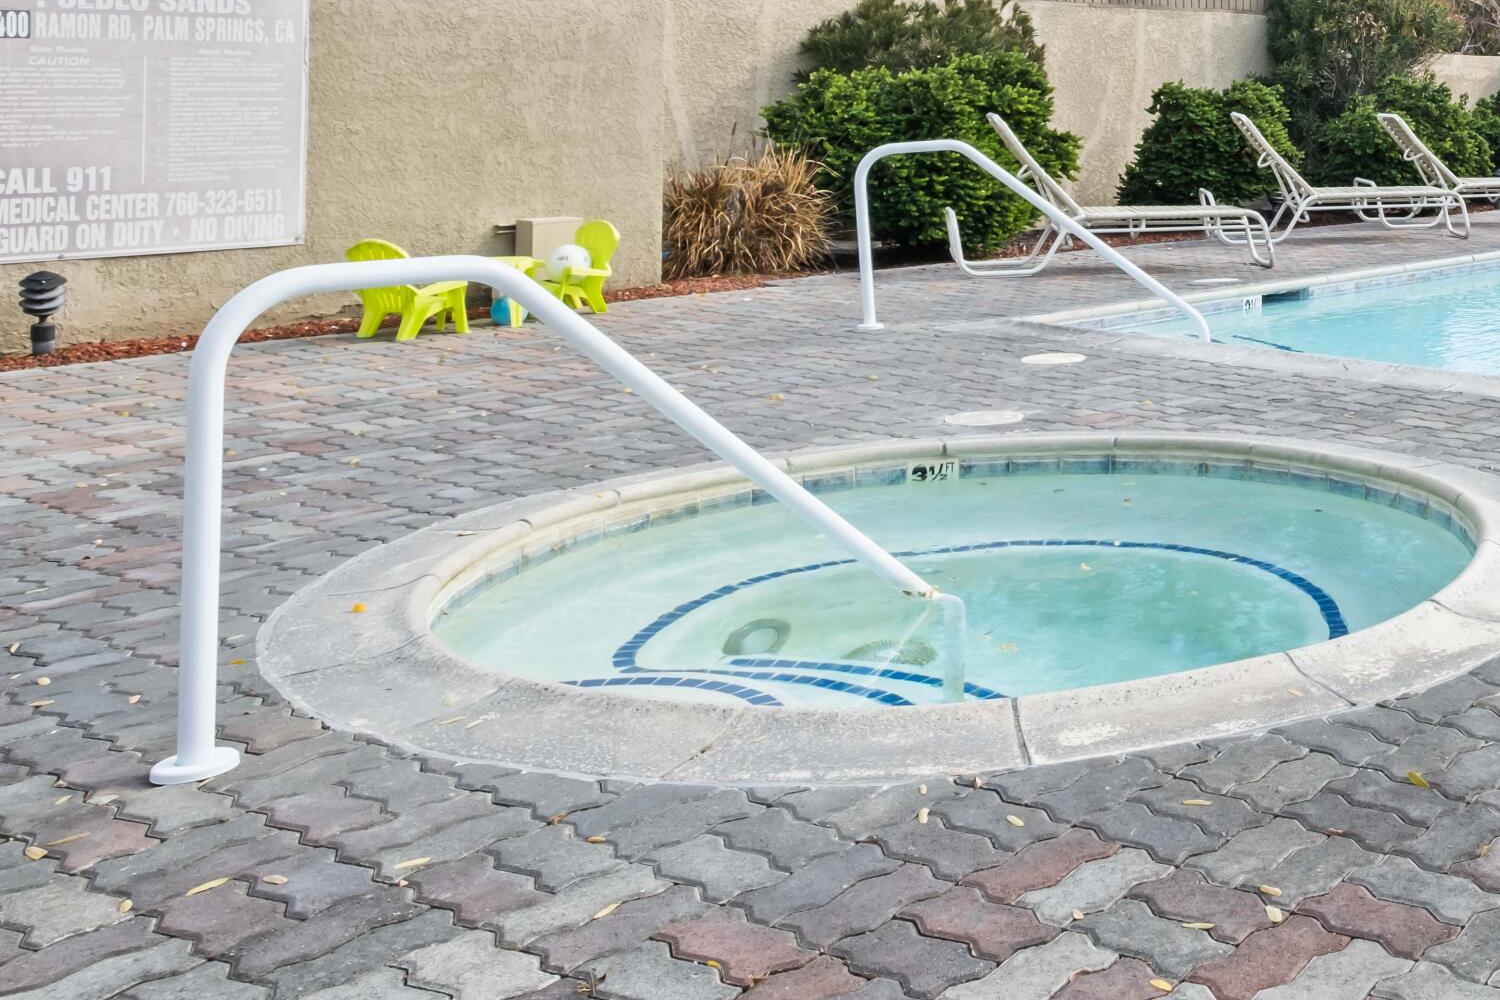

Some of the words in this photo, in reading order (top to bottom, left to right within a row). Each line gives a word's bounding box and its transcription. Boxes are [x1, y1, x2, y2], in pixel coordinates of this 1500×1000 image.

[35, 12, 101, 39] RAMON
[108, 15, 136, 43] RD,
[143, 15, 189, 41] PALM
[195, 17, 269, 45] SPRINGS,
[275, 20, 295, 43] CA
[28, 56, 90, 66] CAUTION
[67, 166, 112, 192] 911
[86, 193, 159, 220] CENTER
[166, 188, 283, 217] 760-323-6511
[76, 223, 106, 248] ON
[113, 220, 164, 246] DUTY
[191, 217, 219, 242] NO
[224, 214, 286, 241] DIVING
